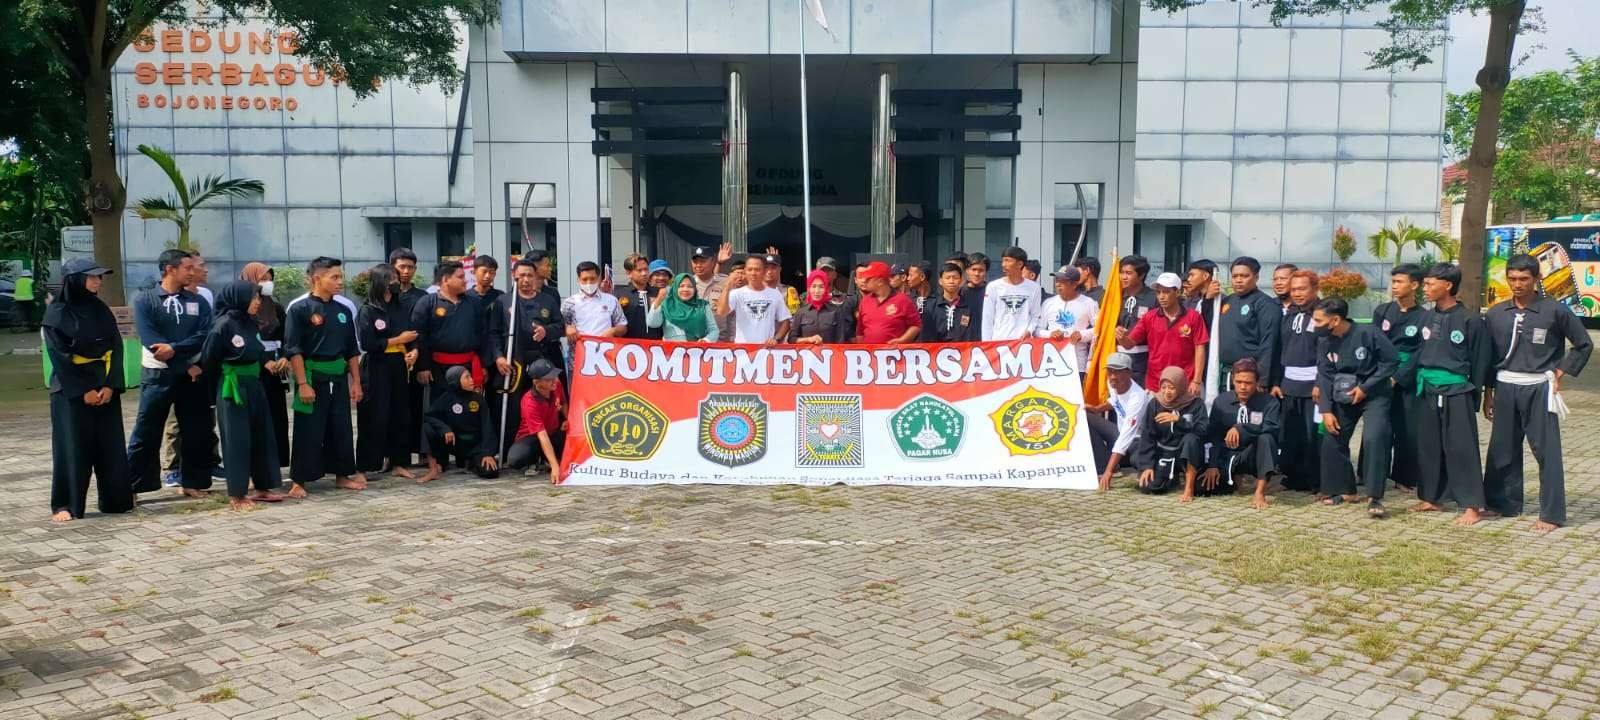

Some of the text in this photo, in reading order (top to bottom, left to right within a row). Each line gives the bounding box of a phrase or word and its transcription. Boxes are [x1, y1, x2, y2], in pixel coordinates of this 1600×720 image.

[137, 94, 298, 112] BOJONEGORO
[580, 340, 1073, 385] KOMITMEN BERSAMA
[620, 402, 660, 434] ORGANISASI
[1003, 398, 1069, 441] MARGALUYU
[1024, 441, 1053, 450] 151
[569, 463, 617, 477] Kultur
[1007, 463, 1087, 481] Kapanpun
